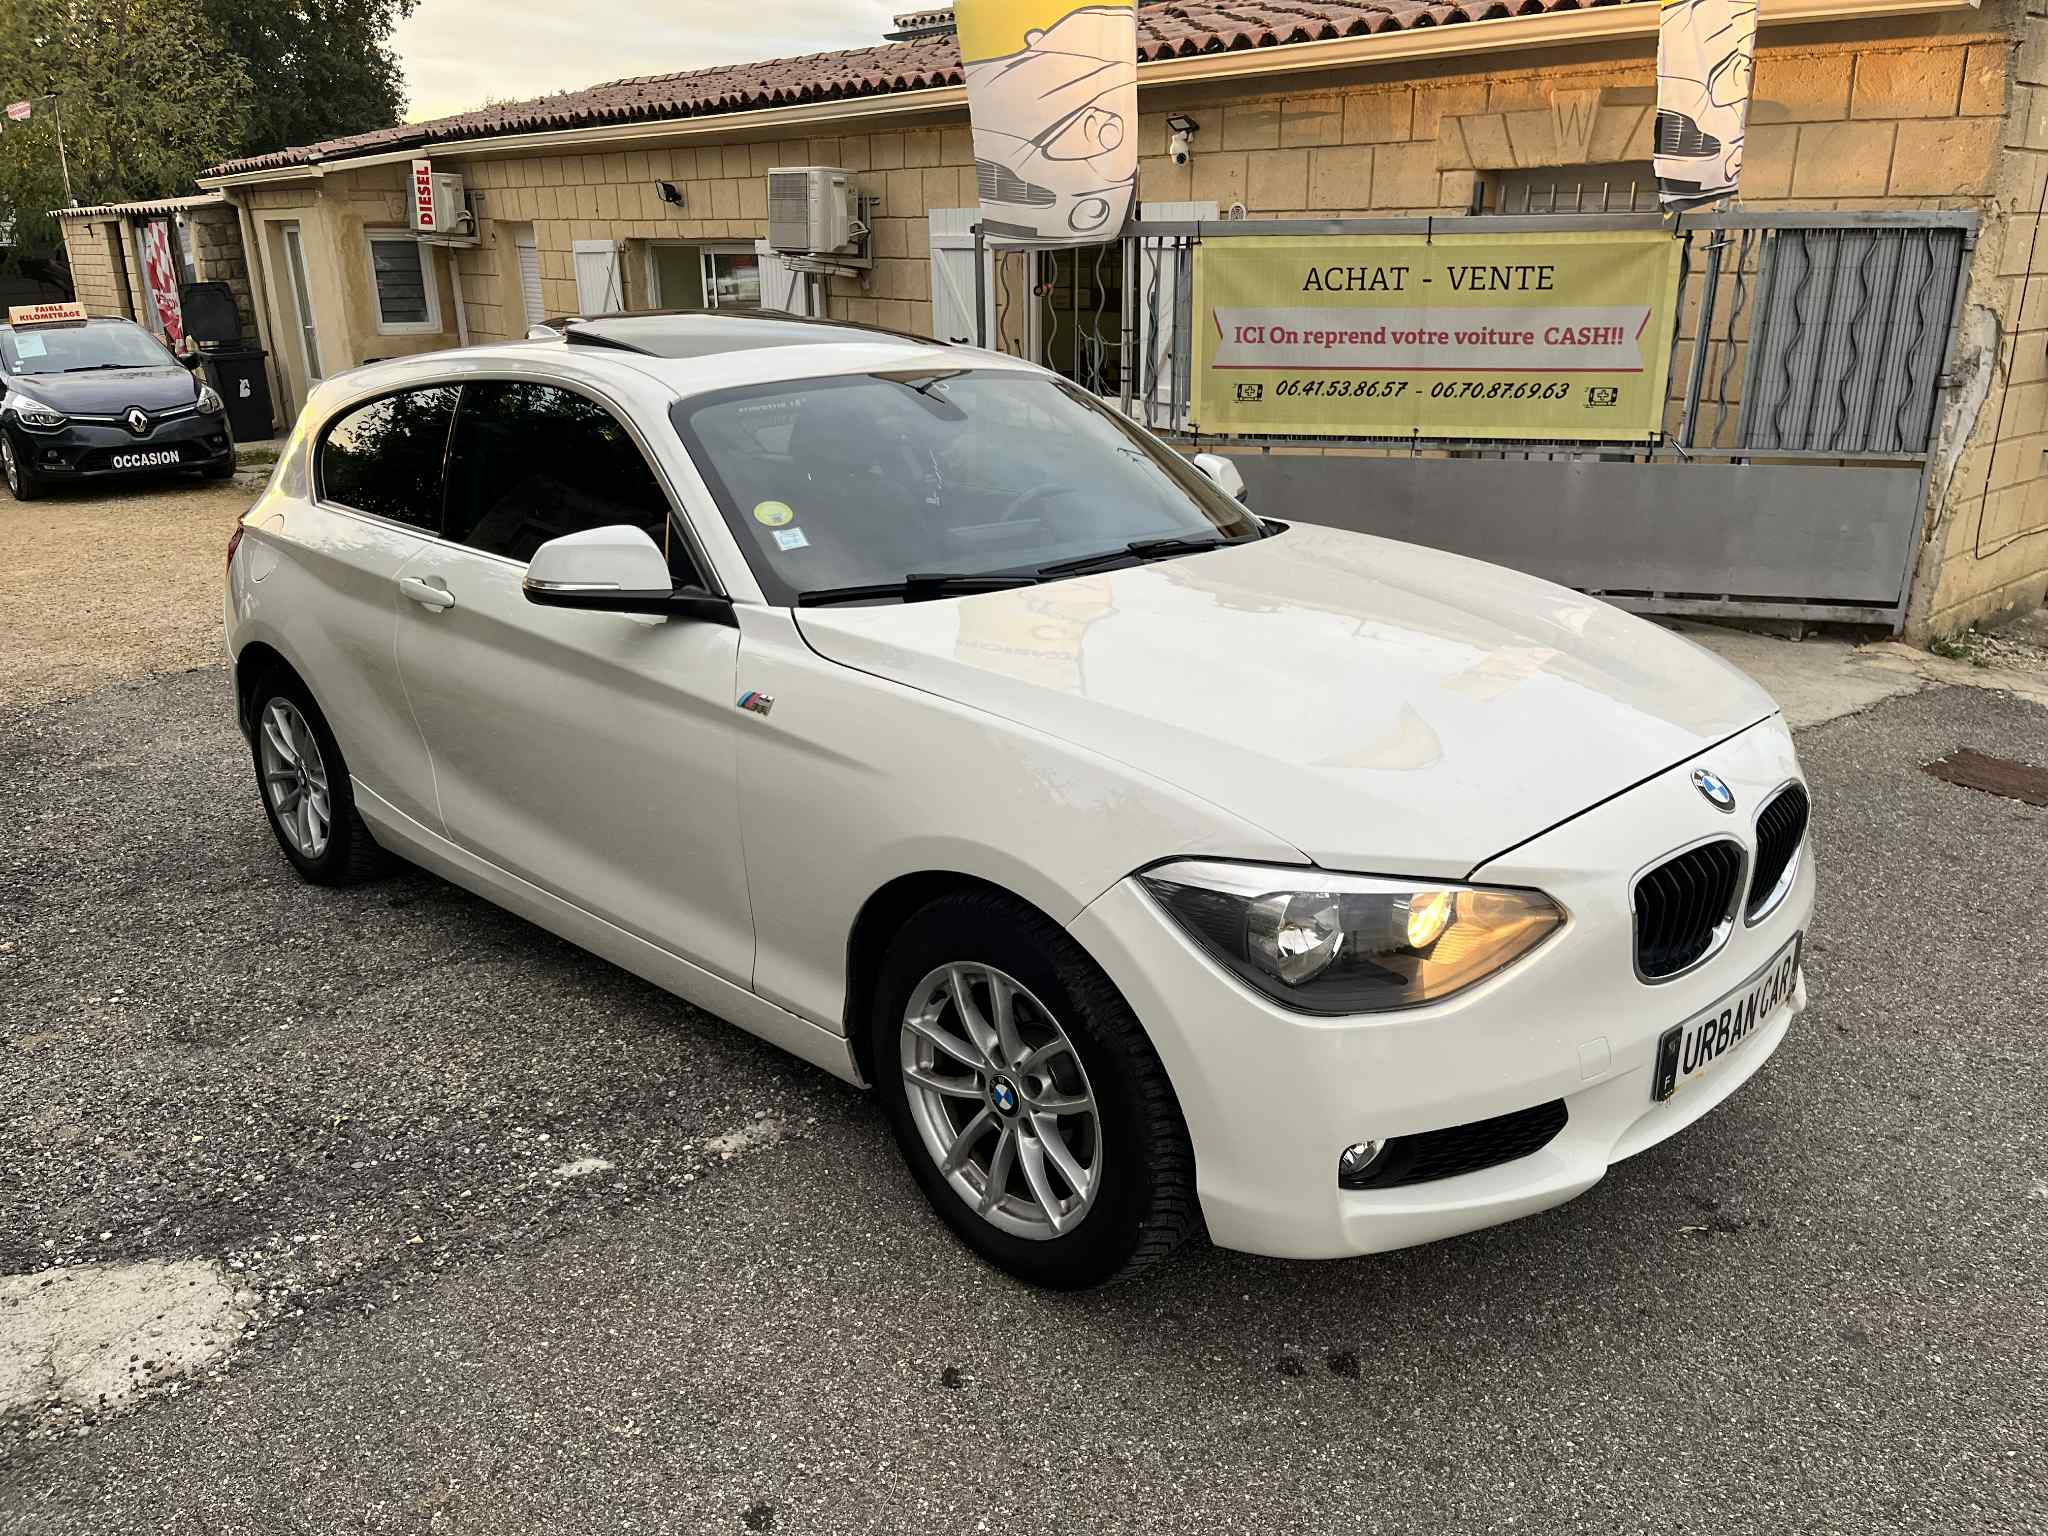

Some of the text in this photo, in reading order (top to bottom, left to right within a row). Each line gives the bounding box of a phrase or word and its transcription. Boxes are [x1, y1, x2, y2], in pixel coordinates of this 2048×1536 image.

[416, 167, 433, 225] DIESEL
[1302, 267, 1409, 291] ACHAT
[1447, 266, 1555, 290] VENTE
[19, 310, 81, 321] KILOMETRAGE
[34, 305, 64, 313] FAIBLE
[1234, 326, 1624, 348] ICI On reprend votre voiture CASH!!
[1275, 380, 1408, 397] 06.41.53.86.57
[1431, 382, 1570, 399] 06.70.87.69.63
[113, 450, 180, 469] OCCASION
[1683, 955, 1791, 1074] URBAN CAR
